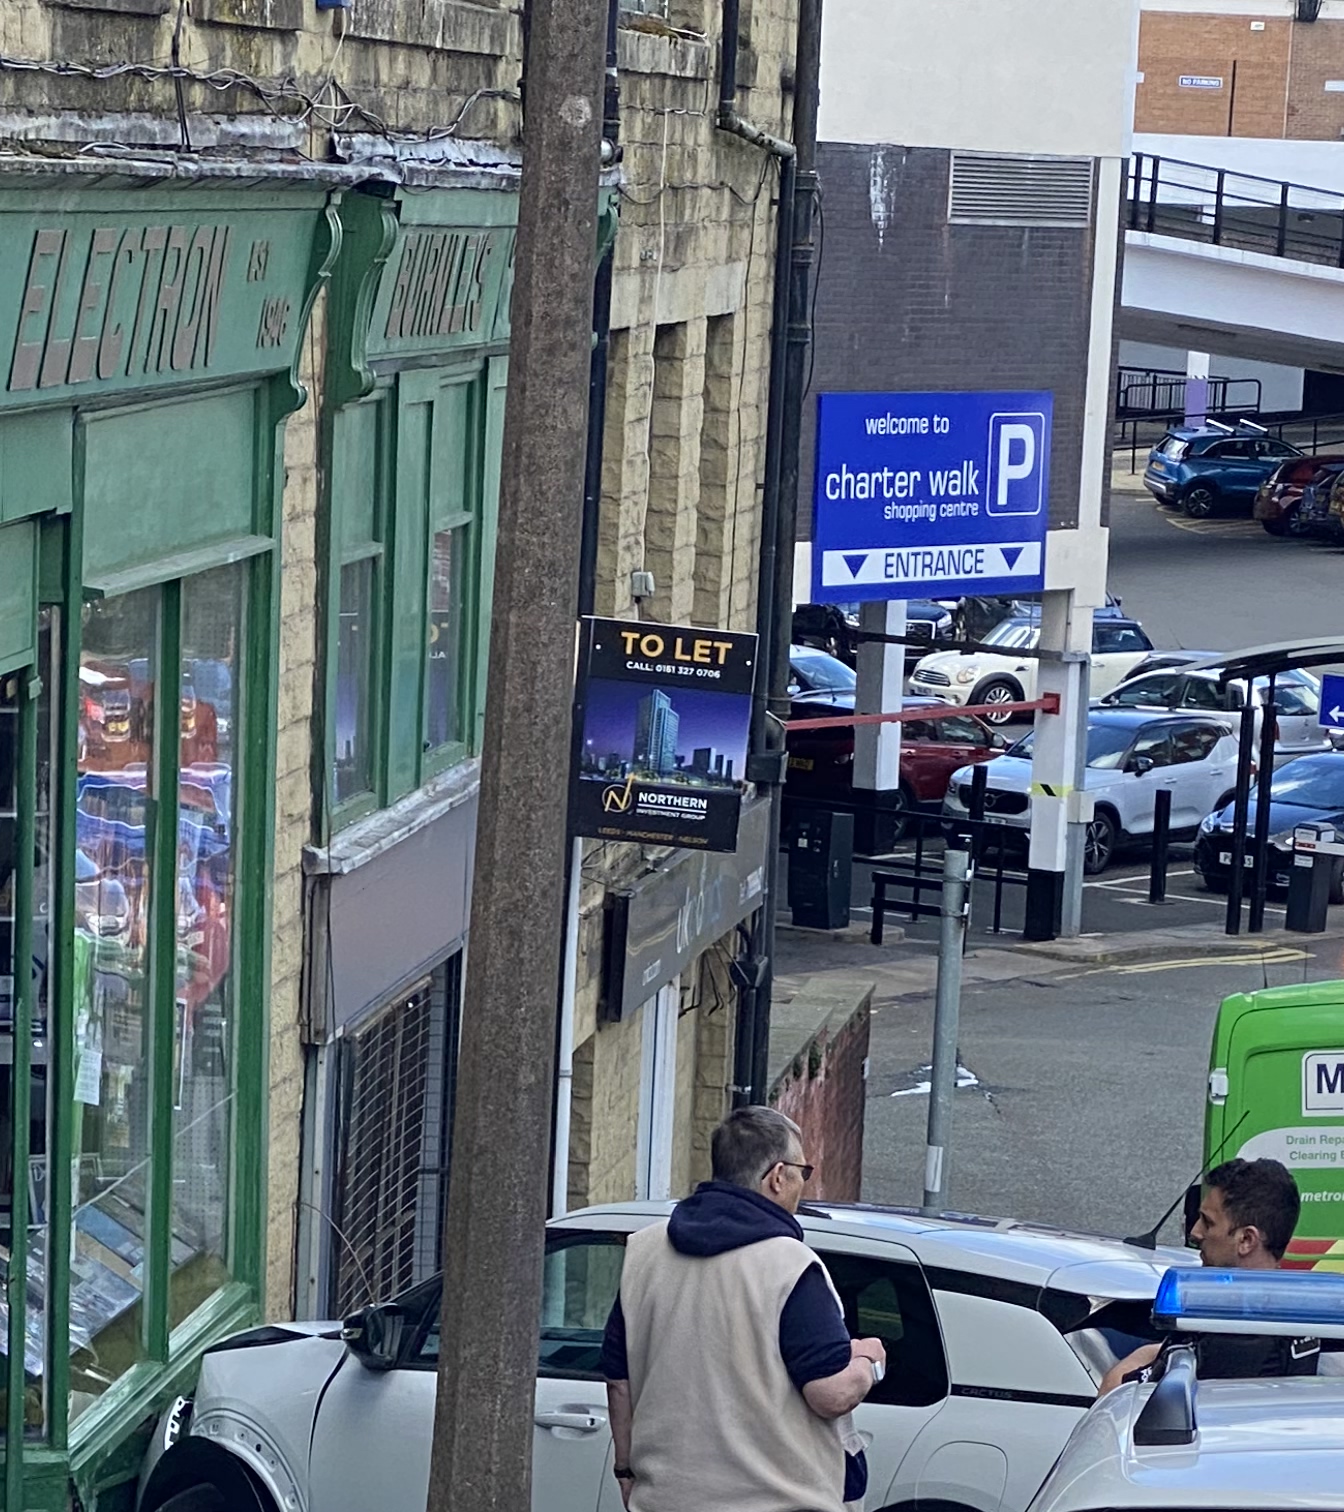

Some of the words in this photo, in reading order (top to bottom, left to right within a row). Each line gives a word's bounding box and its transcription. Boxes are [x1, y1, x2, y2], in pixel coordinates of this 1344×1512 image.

[6, 224, 233, 392] ELECTRON
[865, 412, 929, 435] welcome
[933, 414, 950, 434] to
[997, 423, 1036, 506] P
[825, 463, 921, 500] charter
[929, 460, 980, 496] walk
[884, 500, 937, 522] shopping
[939, 501, 979, 518] centre
[884, 548, 985, 579] ENTRANCE
[621, 631, 665, 658] TO
[674, 637, 733, 665] LET
[626, 661, 654, 672] CALL:
[677, 665, 695, 676] 327
[696, 666, 721, 679] 0706
[638, 791, 707, 810] NORTHERN
[680, 812, 706, 821] GROUP
[1286, 1134, 1317, 1145] Drain
[1289, 1150, 1337, 1162] Clearing
